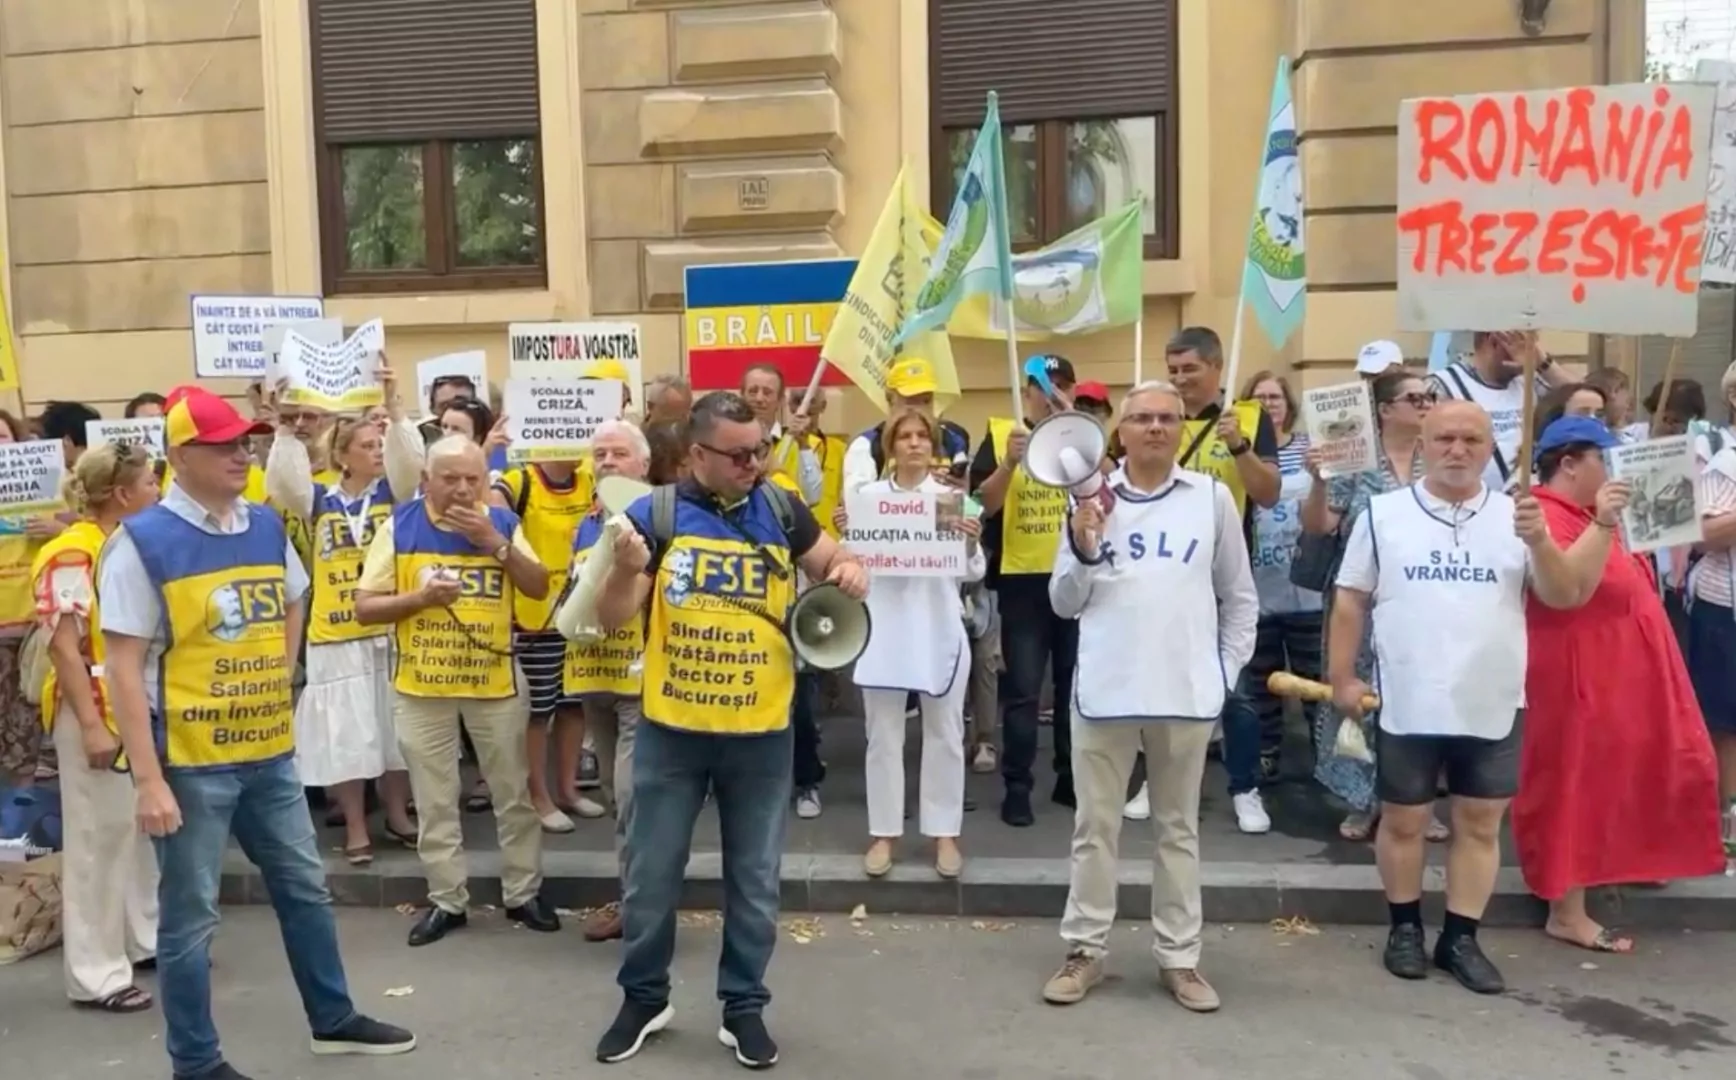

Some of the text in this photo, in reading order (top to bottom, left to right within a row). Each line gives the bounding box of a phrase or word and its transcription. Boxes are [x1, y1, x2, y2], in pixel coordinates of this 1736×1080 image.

[196, 303, 236, 318] ÎNAINTE
[238, 306, 252, 318] DE
[278, 303, 320, 318] ÎNTREBA
[512, 328, 639, 361] IMPOSTURA VOASTRĂ
[576, 387, 595, 396] E-N
[521, 427, 596, 440] CONCEDI
[879, 500, 929, 516] David,
[845, 529, 910, 544] EDUCAȚIA
[914, 531, 932, 541] nu
[696, 552, 765, 594] FSE
[1404, 566, 1498, 583] VRANCEA
[671, 621, 755, 644] Sindicat
[669, 662, 755, 686] Sector 5
[662, 680, 758, 712] București
[182, 704, 220, 722] din
